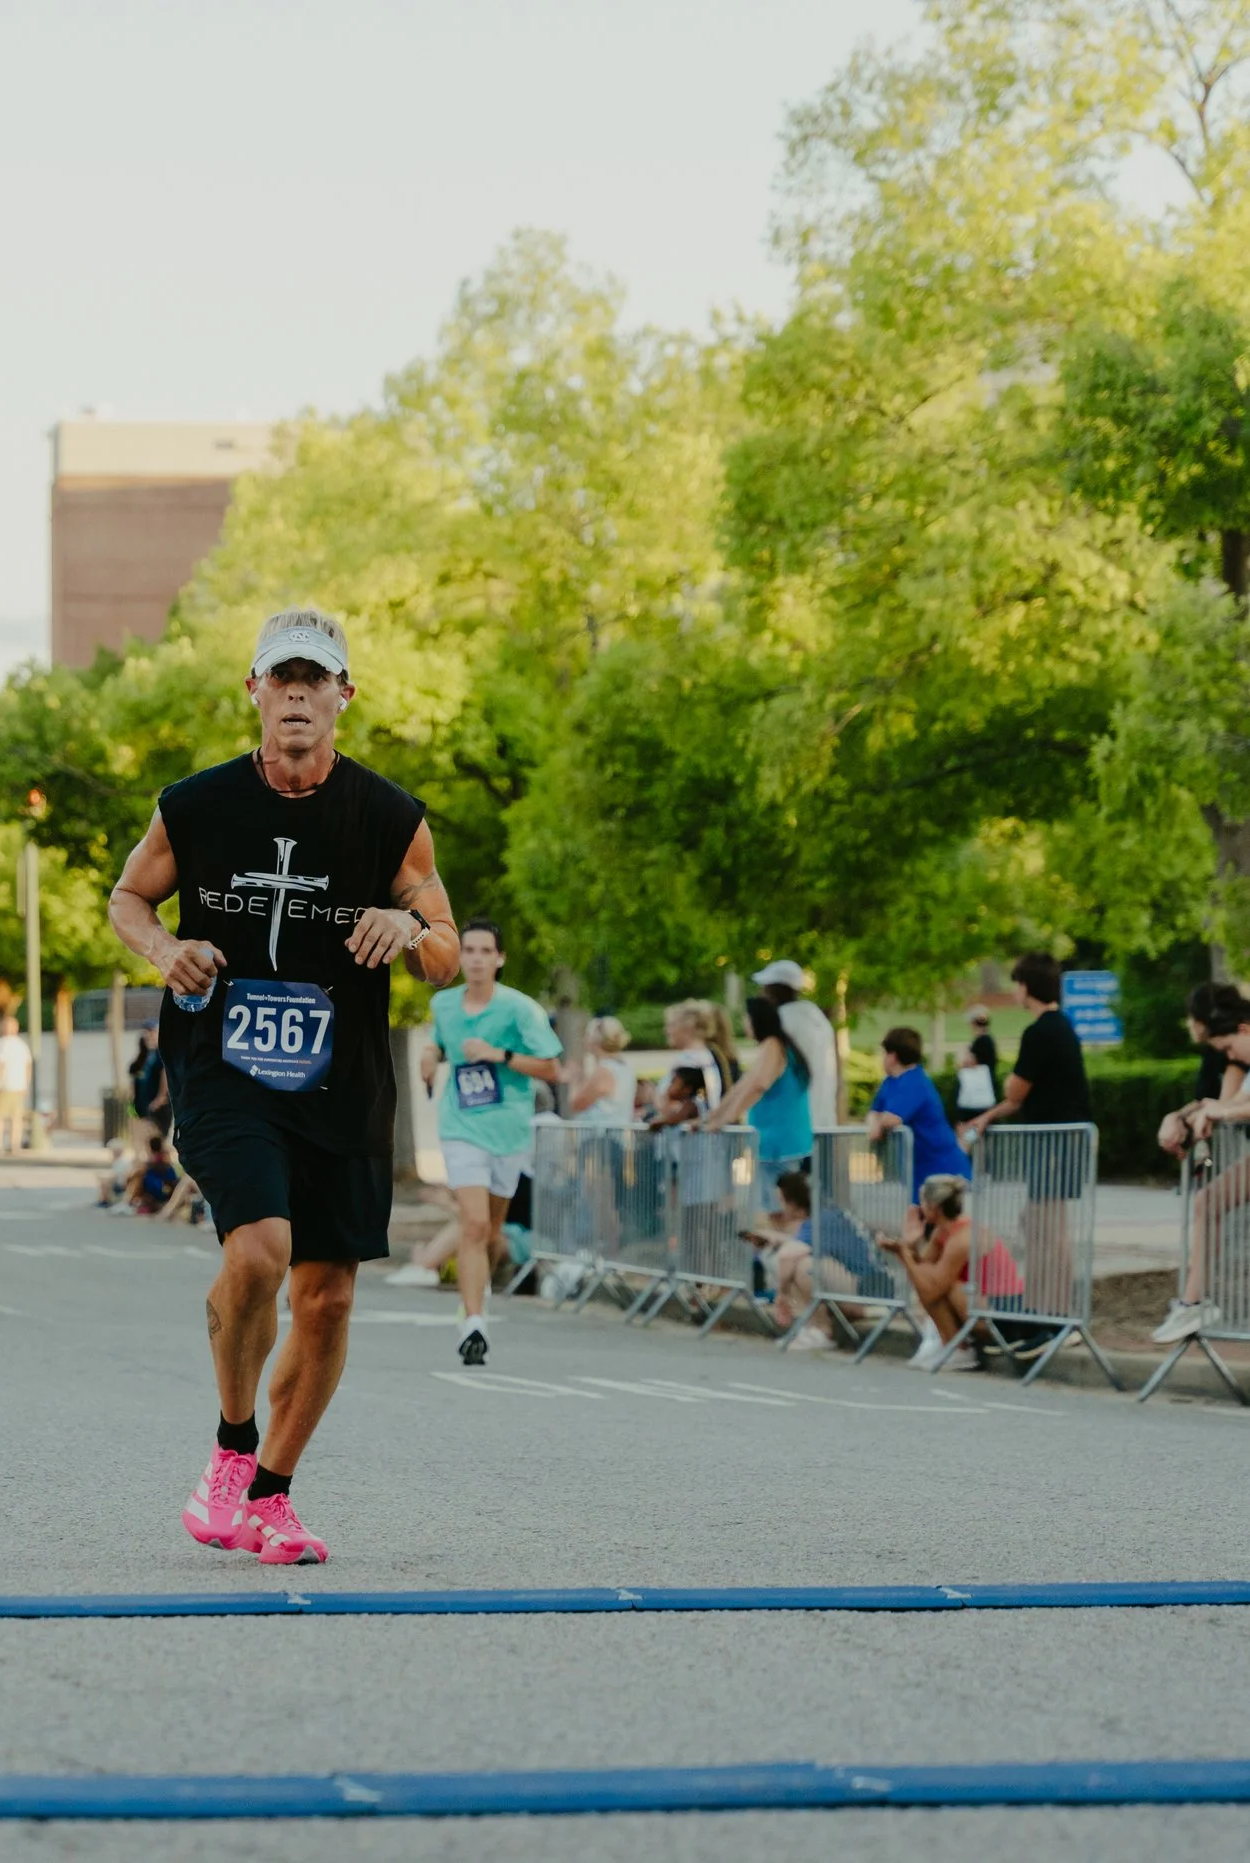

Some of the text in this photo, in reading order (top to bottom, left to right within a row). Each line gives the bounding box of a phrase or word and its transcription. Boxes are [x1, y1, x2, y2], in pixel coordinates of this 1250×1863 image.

[286, 995, 316, 1004] Foundation
[226, 1004, 331, 1055] 2567
[257, 1068, 306, 1078] Lexington Health
